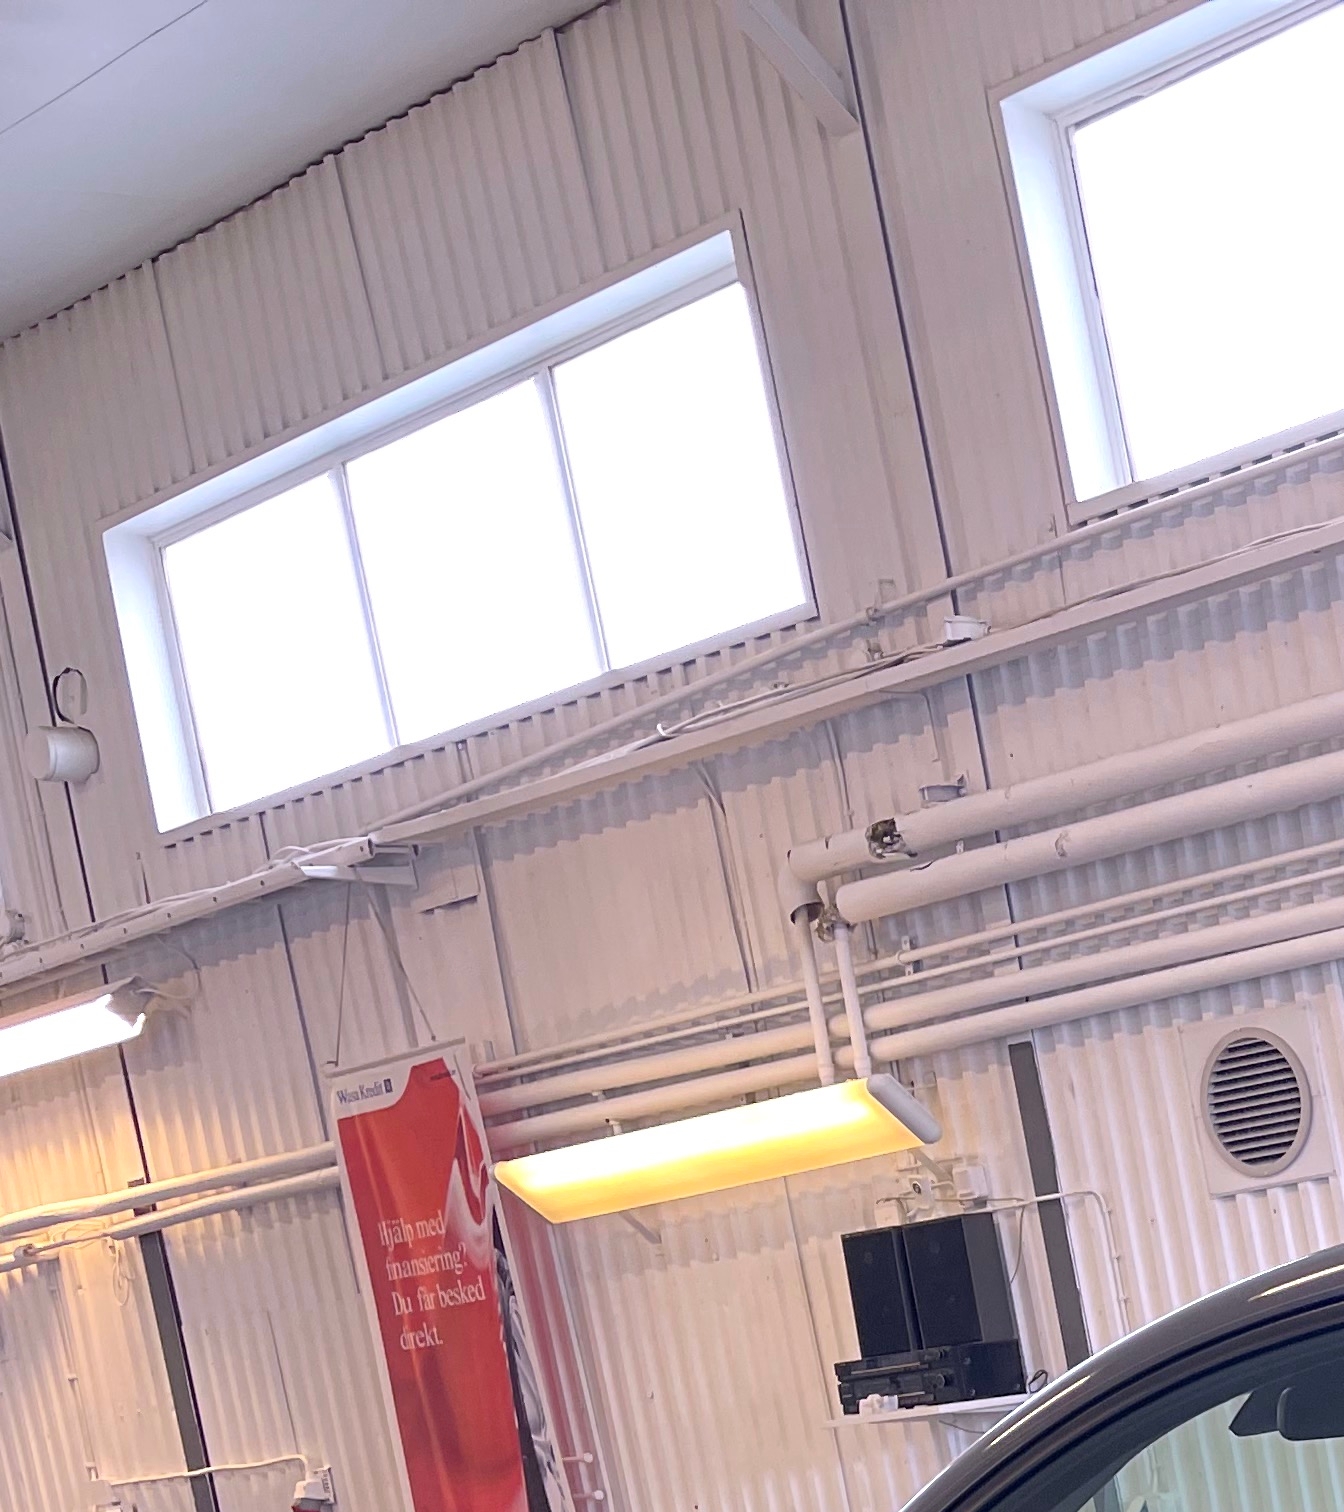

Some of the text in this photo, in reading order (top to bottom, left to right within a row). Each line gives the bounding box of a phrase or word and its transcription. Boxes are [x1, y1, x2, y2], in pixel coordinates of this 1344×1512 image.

[415, 1209, 446, 1239] med
[385, 1241, 468, 1280] finansiering?
[391, 1291, 413, 1316] Du
[436, 1275, 486, 1308] besked
